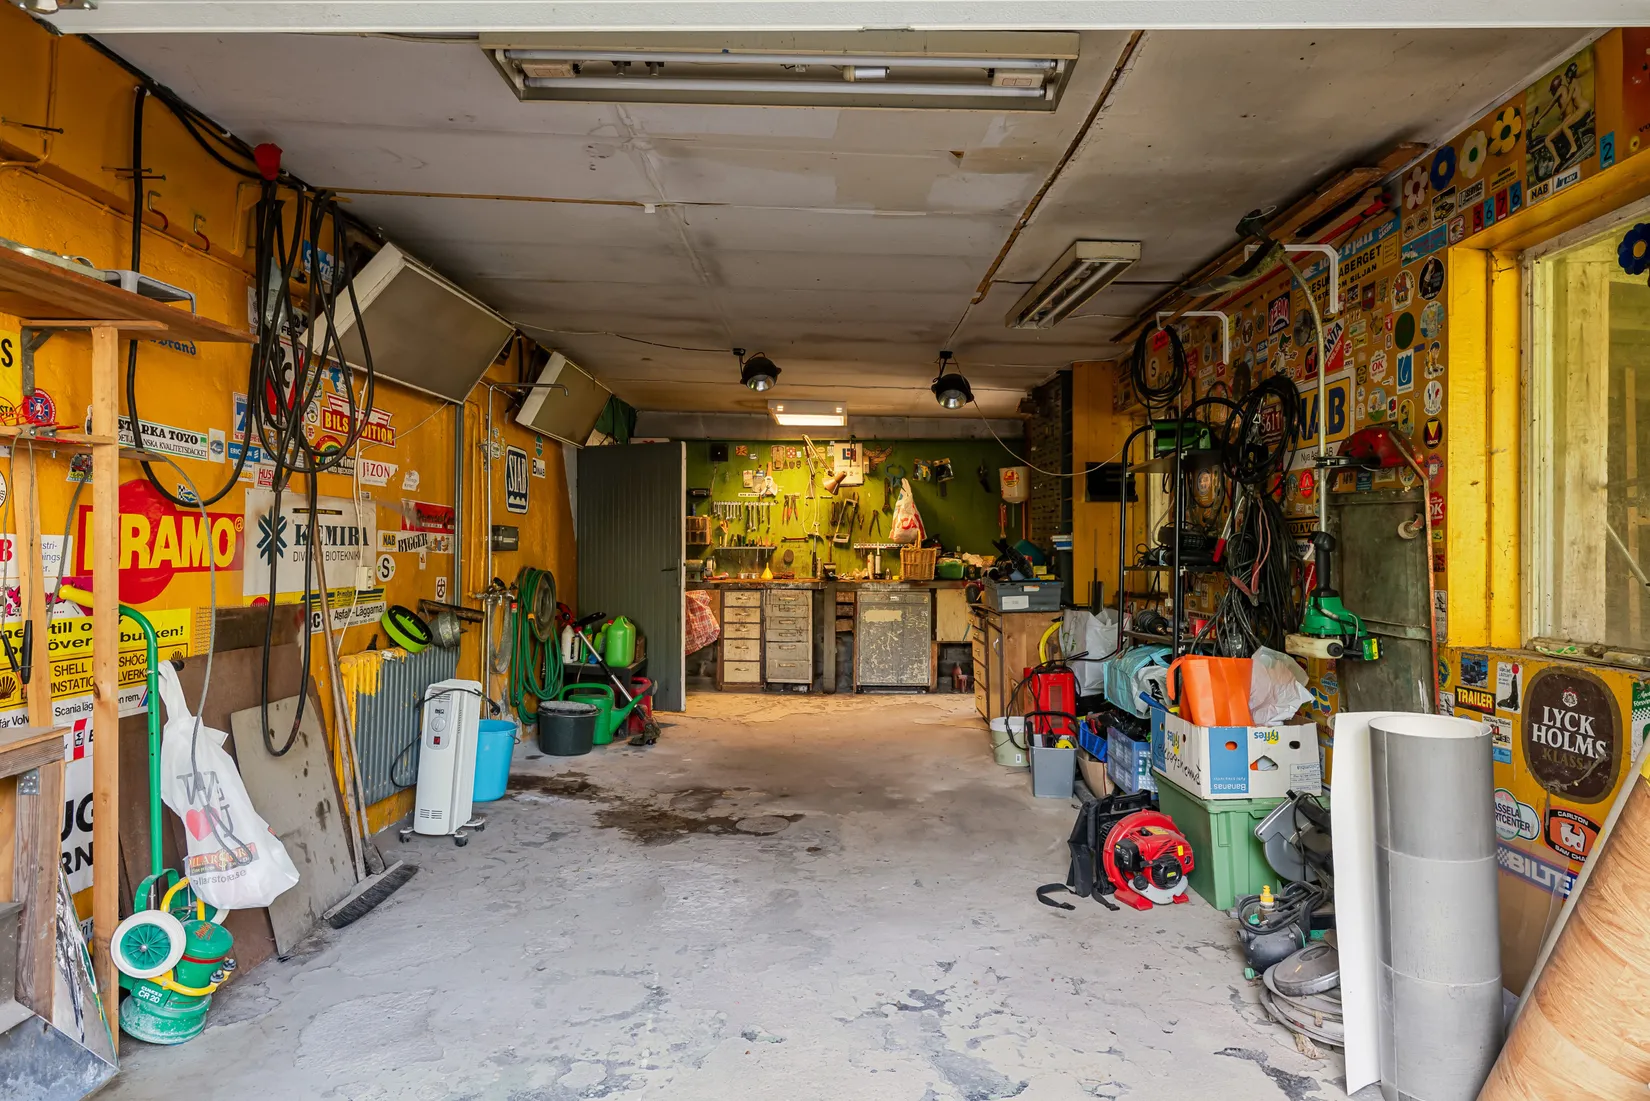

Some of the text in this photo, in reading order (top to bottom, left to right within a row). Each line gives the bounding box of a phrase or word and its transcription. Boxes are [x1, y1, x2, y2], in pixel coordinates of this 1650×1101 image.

[1603, 142, 1613, 161] 2
[1531, 184, 1549, 199] NAB
[1372, 360, 1384, 371] OK
[118, 418, 199, 445] STRKA TOYO
[383, 533, 396, 546] NAB
[381, 557, 390, 579] S
[49, 622, 73, 635] till
[54, 662, 88, 677] SHELL
[1457, 688, 1493, 708] TRAILER
[55, 702, 82, 717] Scania
[1542, 705, 1596, 737] LYCK
[1532, 723, 1608, 759] HOLMS
[1213, 782, 1247, 791] Bananas
[1557, 810, 1589, 826] CARLTON
[1555, 845, 1570, 856] SAW
[138, 990, 150, 1000] CR
[151, 995, 161, 1004] 20
